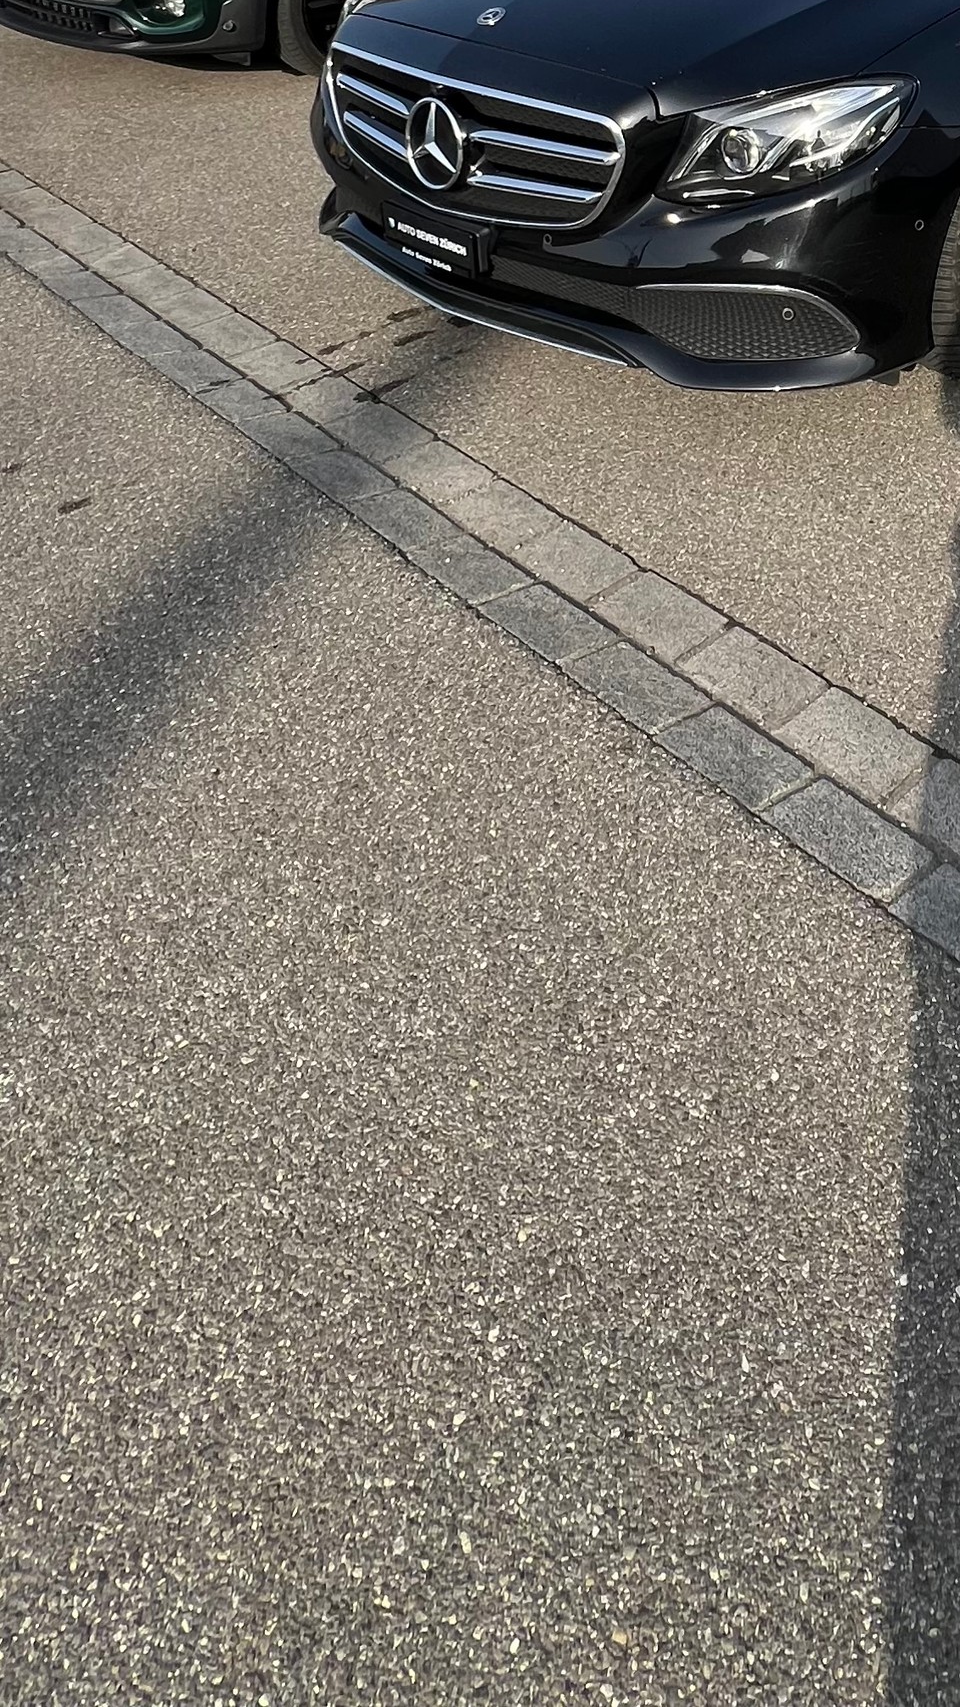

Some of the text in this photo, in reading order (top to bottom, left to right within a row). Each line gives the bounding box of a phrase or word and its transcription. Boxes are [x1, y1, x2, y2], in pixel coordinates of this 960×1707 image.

[397, 221, 467, 256] AUTO SEVEN ZÜRICH
